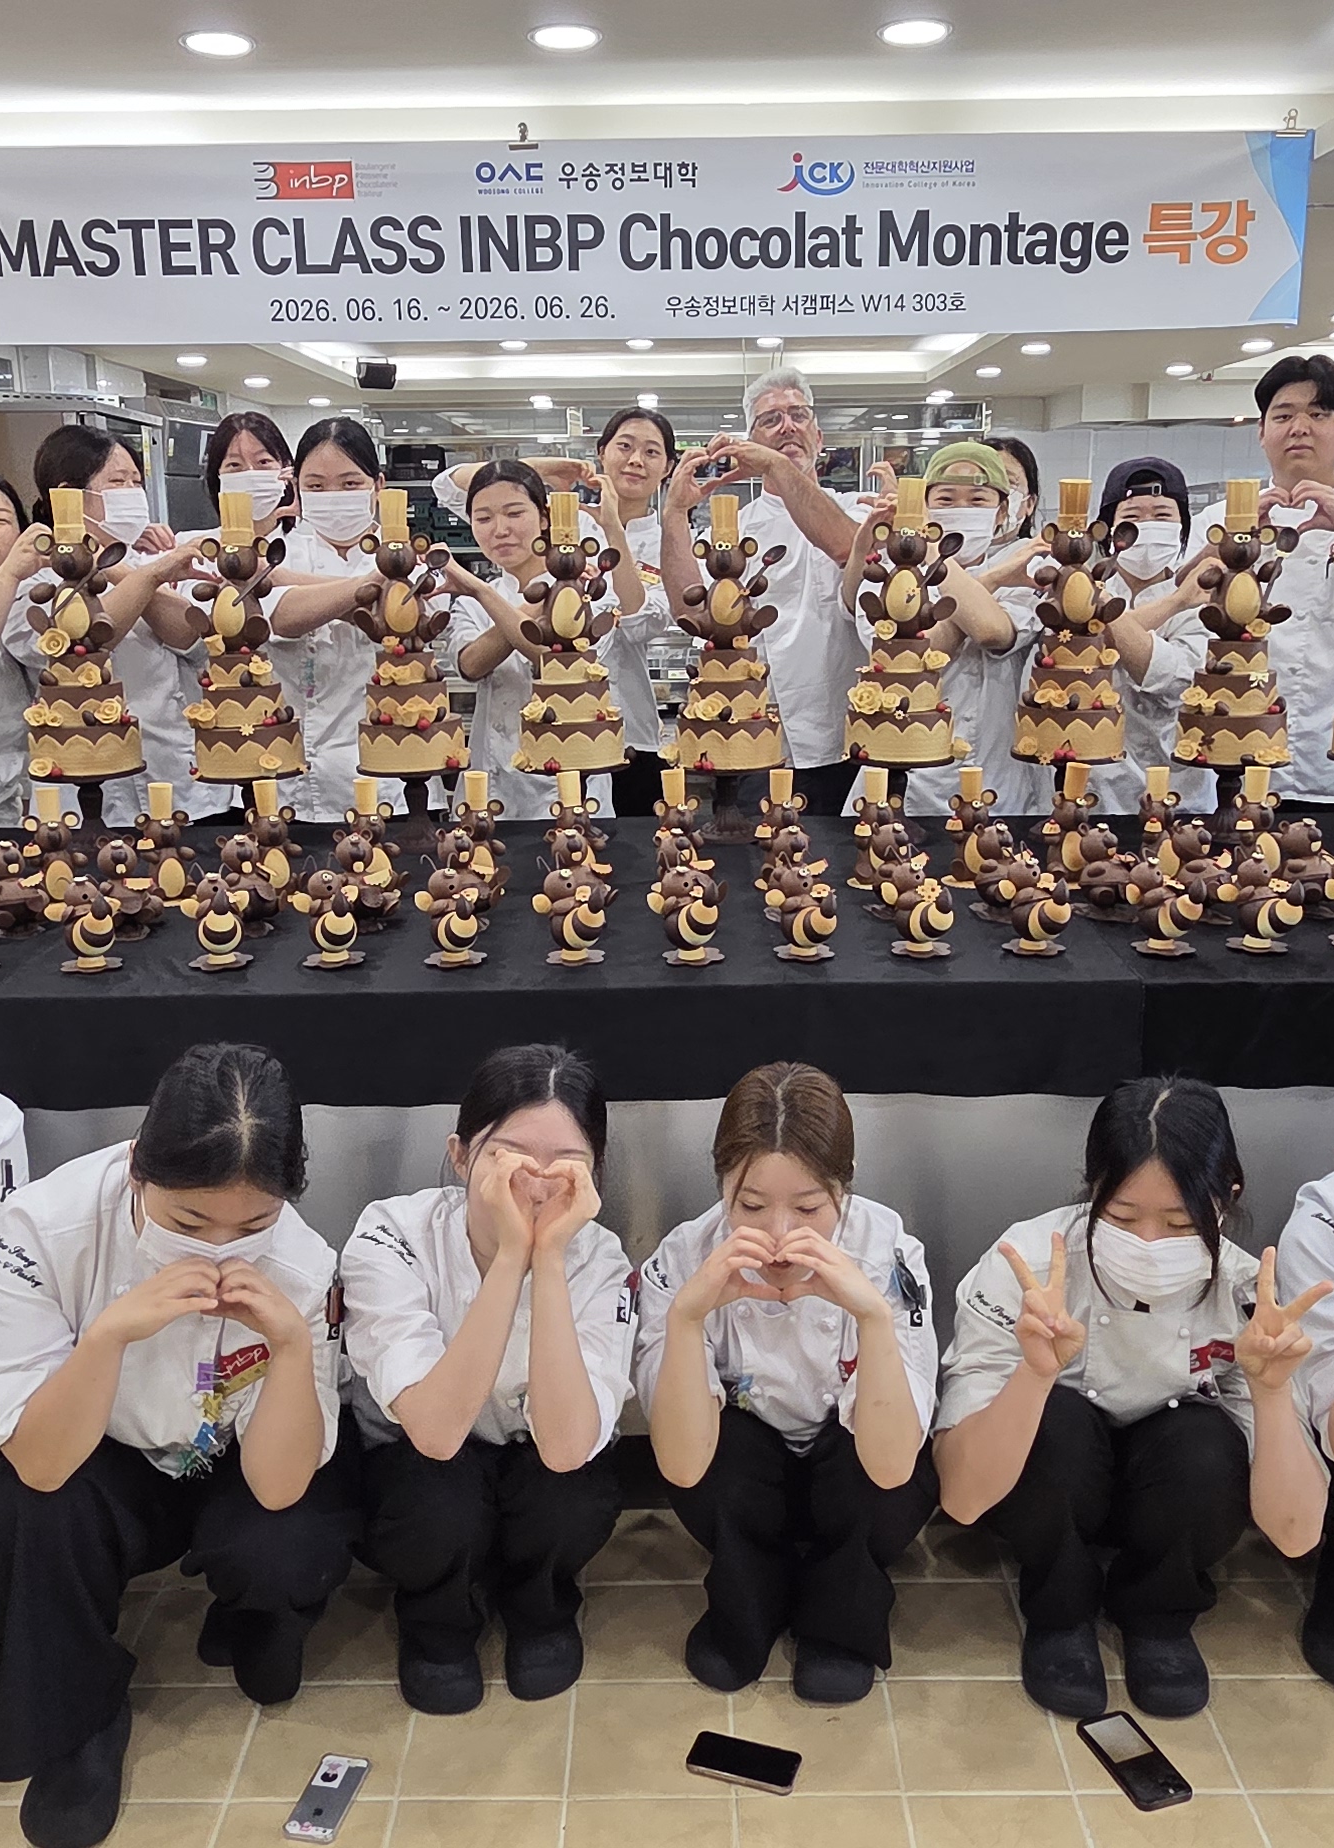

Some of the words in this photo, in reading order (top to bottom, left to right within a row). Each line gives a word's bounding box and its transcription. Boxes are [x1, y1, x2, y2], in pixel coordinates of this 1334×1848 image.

[289, 164, 349, 197] inbp
[558, 161, 699, 192] 우송정보대학
[862, 159, 976, 175] 전문대학혁신지원사업
[513, 187, 544, 195] COLLEGE
[862, 180, 905, 189] Innovation
[907, 180, 938, 190] College
[940, 179, 950, 188] of
[951, 179, 977, 188] Korea
[252, 215, 446, 275] CLASS
[459, 213, 605, 273] INBP
[619, 211, 864, 272] Chocolat
[878, 210, 1129, 275] Montage
[1142, 200, 1257, 265] 특강
[270, 299, 339, 323] 2026.
[346, 298, 385, 322] 06.
[394, 298, 430, 322] 16.
[459, 297, 528, 321] 2026.
[535, 296, 573, 320] 06.
[580, 295, 616, 320] 26.
[665, 294, 776, 318] 우송정보대학
[781, 292, 856, 317] 서캠퍼스
[862, 294, 906, 315] W14
[912, 291, 967, 315] 303호
